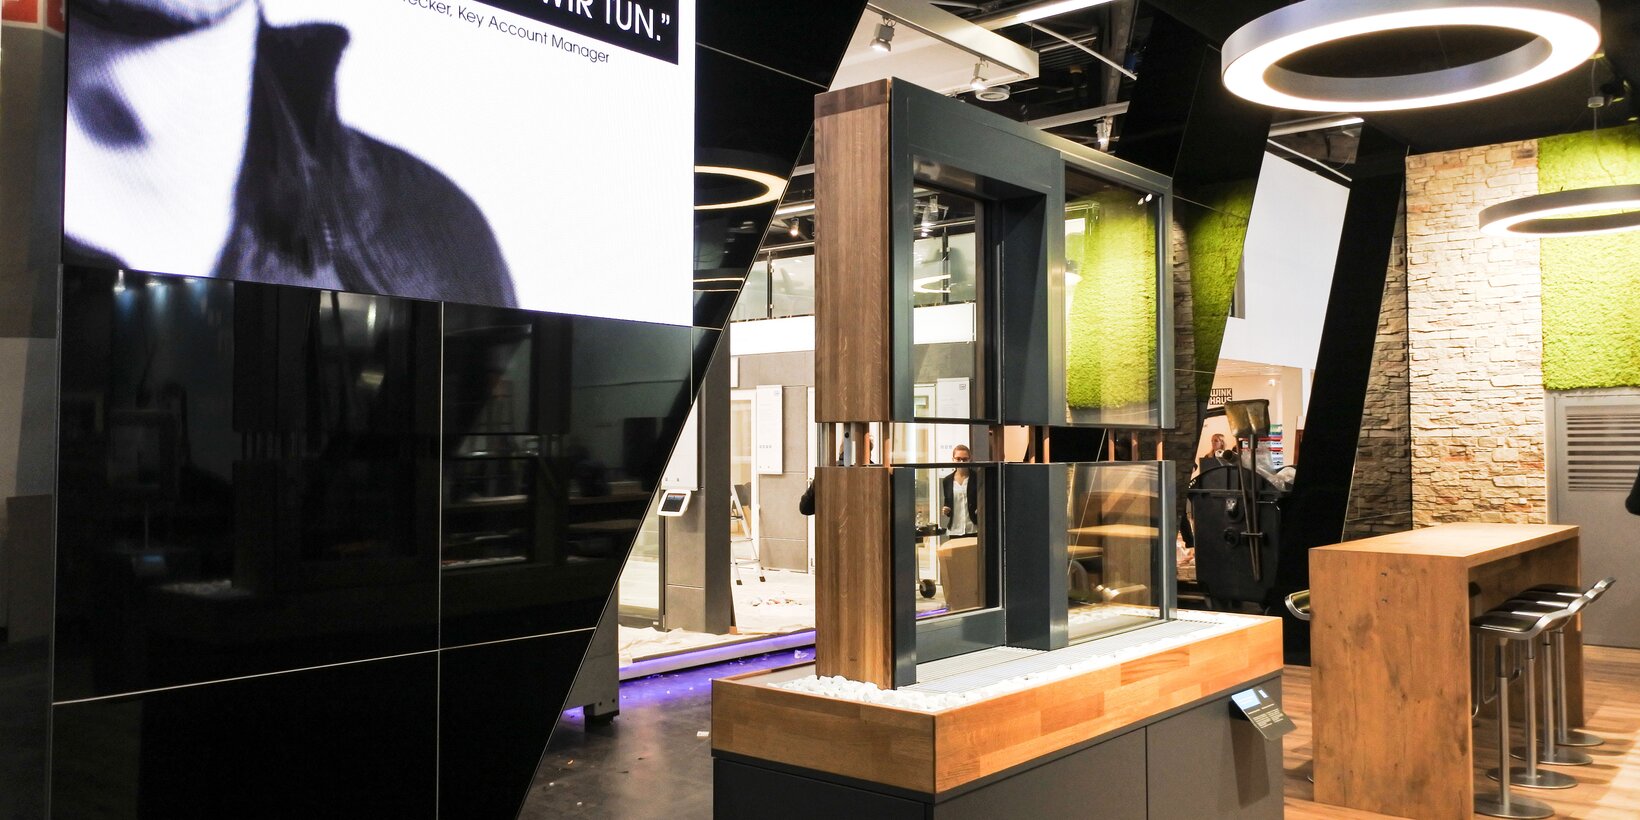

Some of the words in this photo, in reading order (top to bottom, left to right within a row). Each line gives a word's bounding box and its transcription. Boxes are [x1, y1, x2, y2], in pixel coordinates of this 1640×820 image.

[403, 0, 453, 17] cker,
[458, 5, 484, 28] Key
[488, 15, 548, 44] Account
[551, 34, 610, 63] Manager
[1210, 388, 1232, 397] WINK
